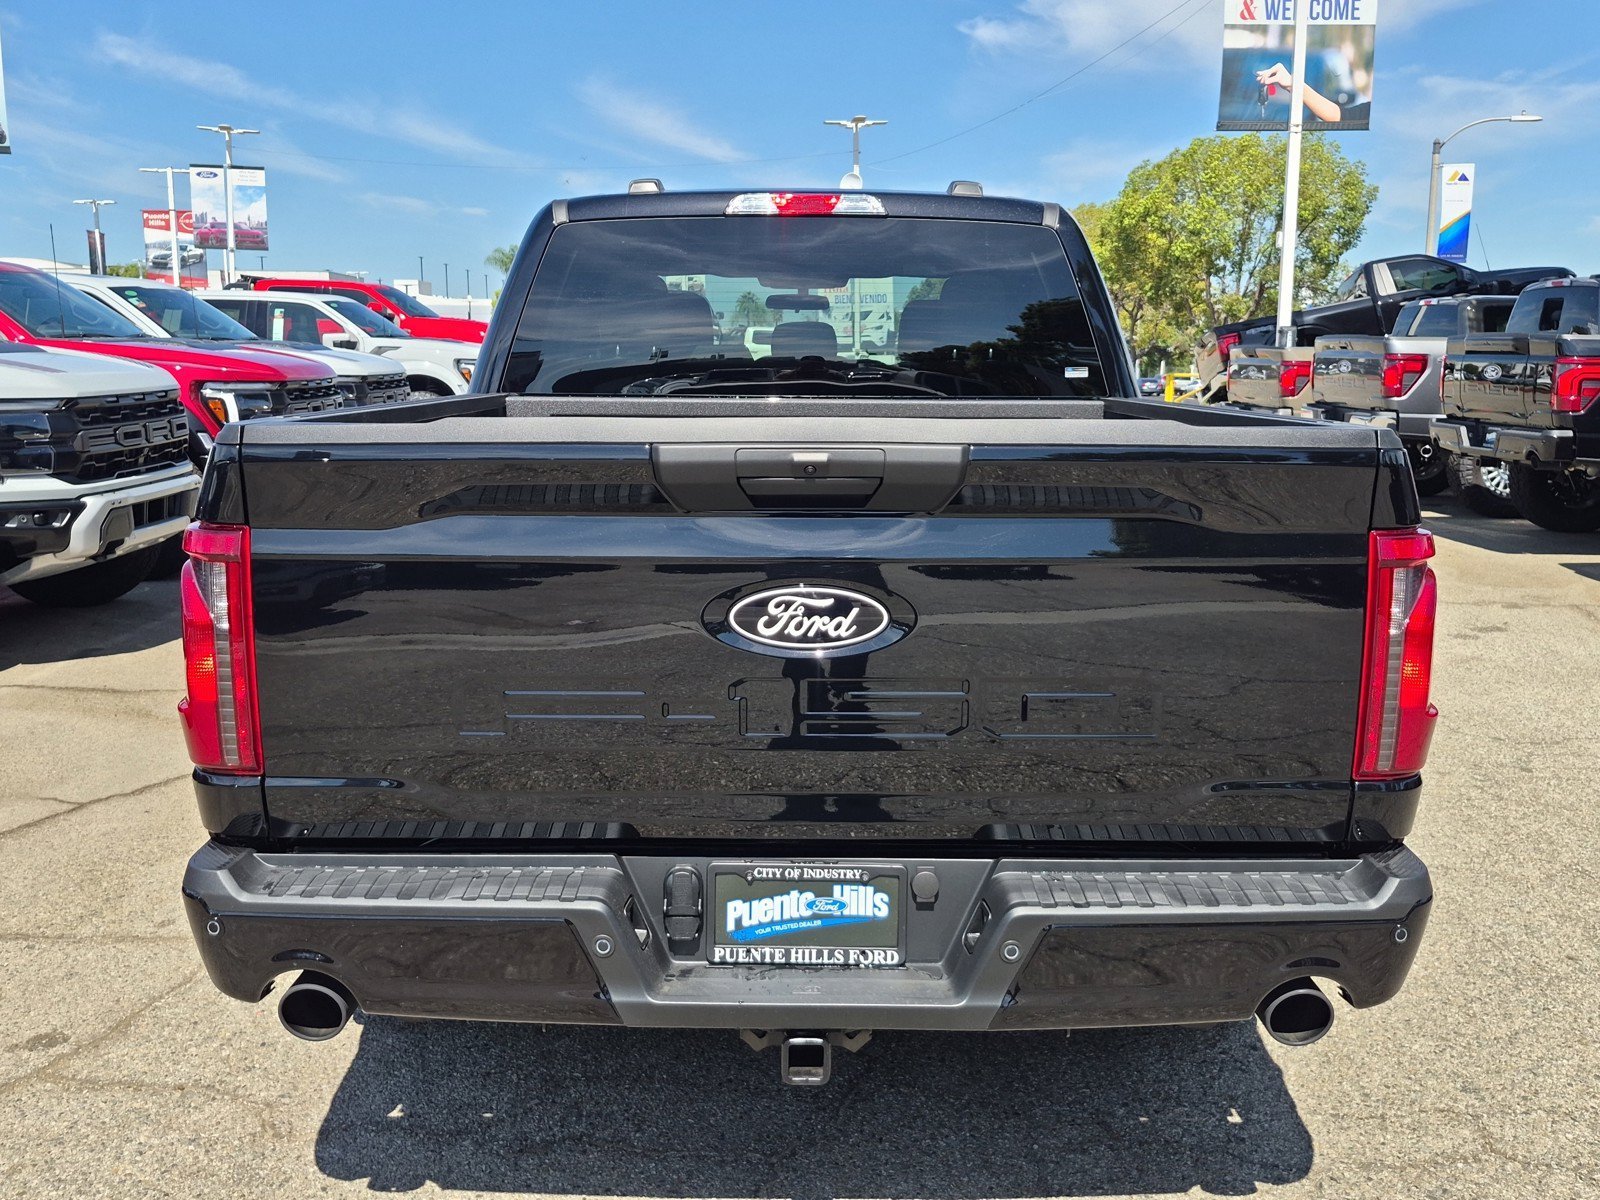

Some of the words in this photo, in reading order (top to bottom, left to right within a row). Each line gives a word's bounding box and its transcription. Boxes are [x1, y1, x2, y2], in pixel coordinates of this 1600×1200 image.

[74, 416, 190, 452] FORD
[756, 595, 860, 638] Ford
[753, 867, 783, 878] CITY
[785, 868, 801, 879] OF
[803, 868, 863, 879] INDUSTRY
[726, 890, 815, 932] Puente
[812, 899, 840, 912] Ford
[833, 884, 890, 918] Hills
[755, 927, 772, 935] YOUR
[771, 922, 799, 932] TRUSTED
[799, 920, 822, 929] DEALER
[713, 947, 786, 963] PUENTE
[790, 948, 845, 963] HILLS
[848, 948, 900, 965] FORD
